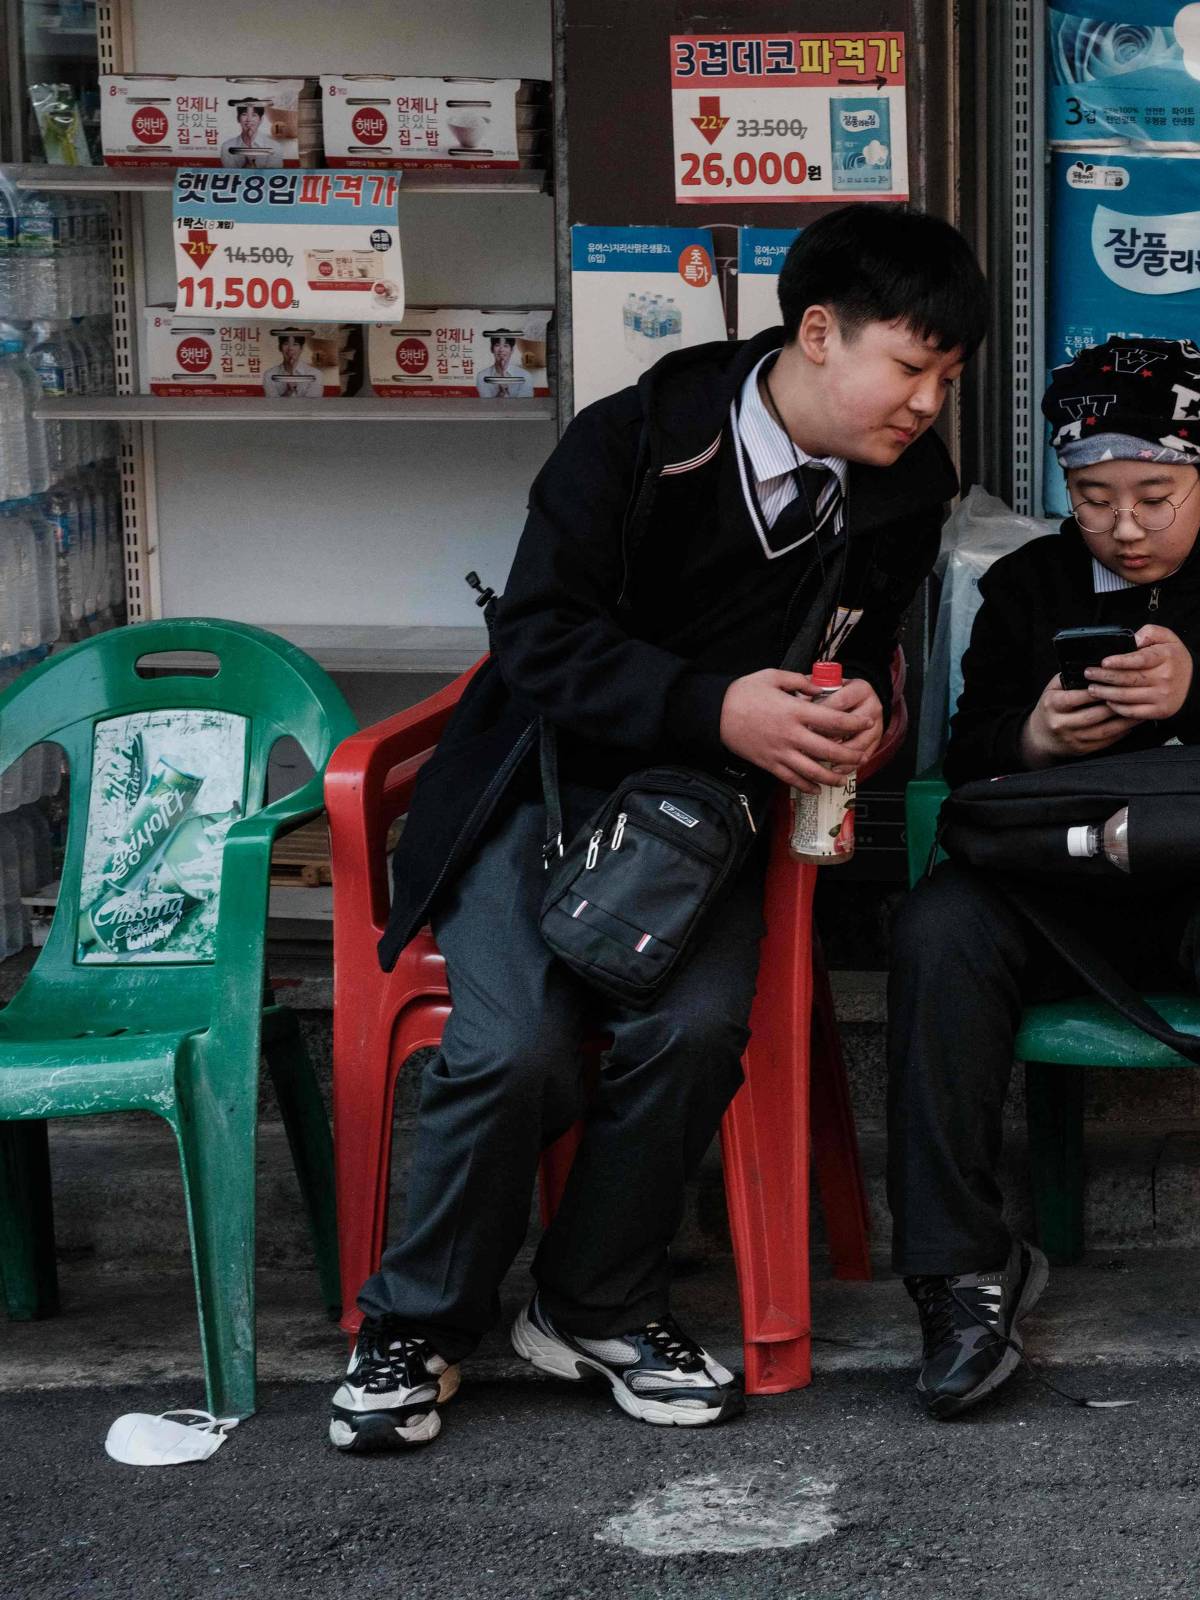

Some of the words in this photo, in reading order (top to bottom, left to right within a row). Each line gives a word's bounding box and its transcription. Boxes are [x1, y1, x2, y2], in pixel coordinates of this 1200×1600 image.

[176, 97, 218, 112] 언제나
[397, 97, 438, 114] 언제나
[136, 118, 164, 135] 햇반
[177, 114, 217, 128] 맛있는
[355, 119, 384, 136] 햇반
[398, 115, 437, 129] 맛있는
[700, 116, 725, 129] 22%
[188, 242, 212, 254] 21%
[588, 255, 605, 264] (6입)
[690, 250, 703, 265] 초
[754, 256, 772, 266] (6입)
[684, 266, 708, 282] 특가
[220, 327, 261, 342] 언제나
[436, 328, 474, 344] 언제나
[181, 348, 208, 364] 햇반
[221, 344, 260, 357] 맛있는
[400, 348, 425, 365] 햇반
[437, 345, 472, 358] 맛있는
